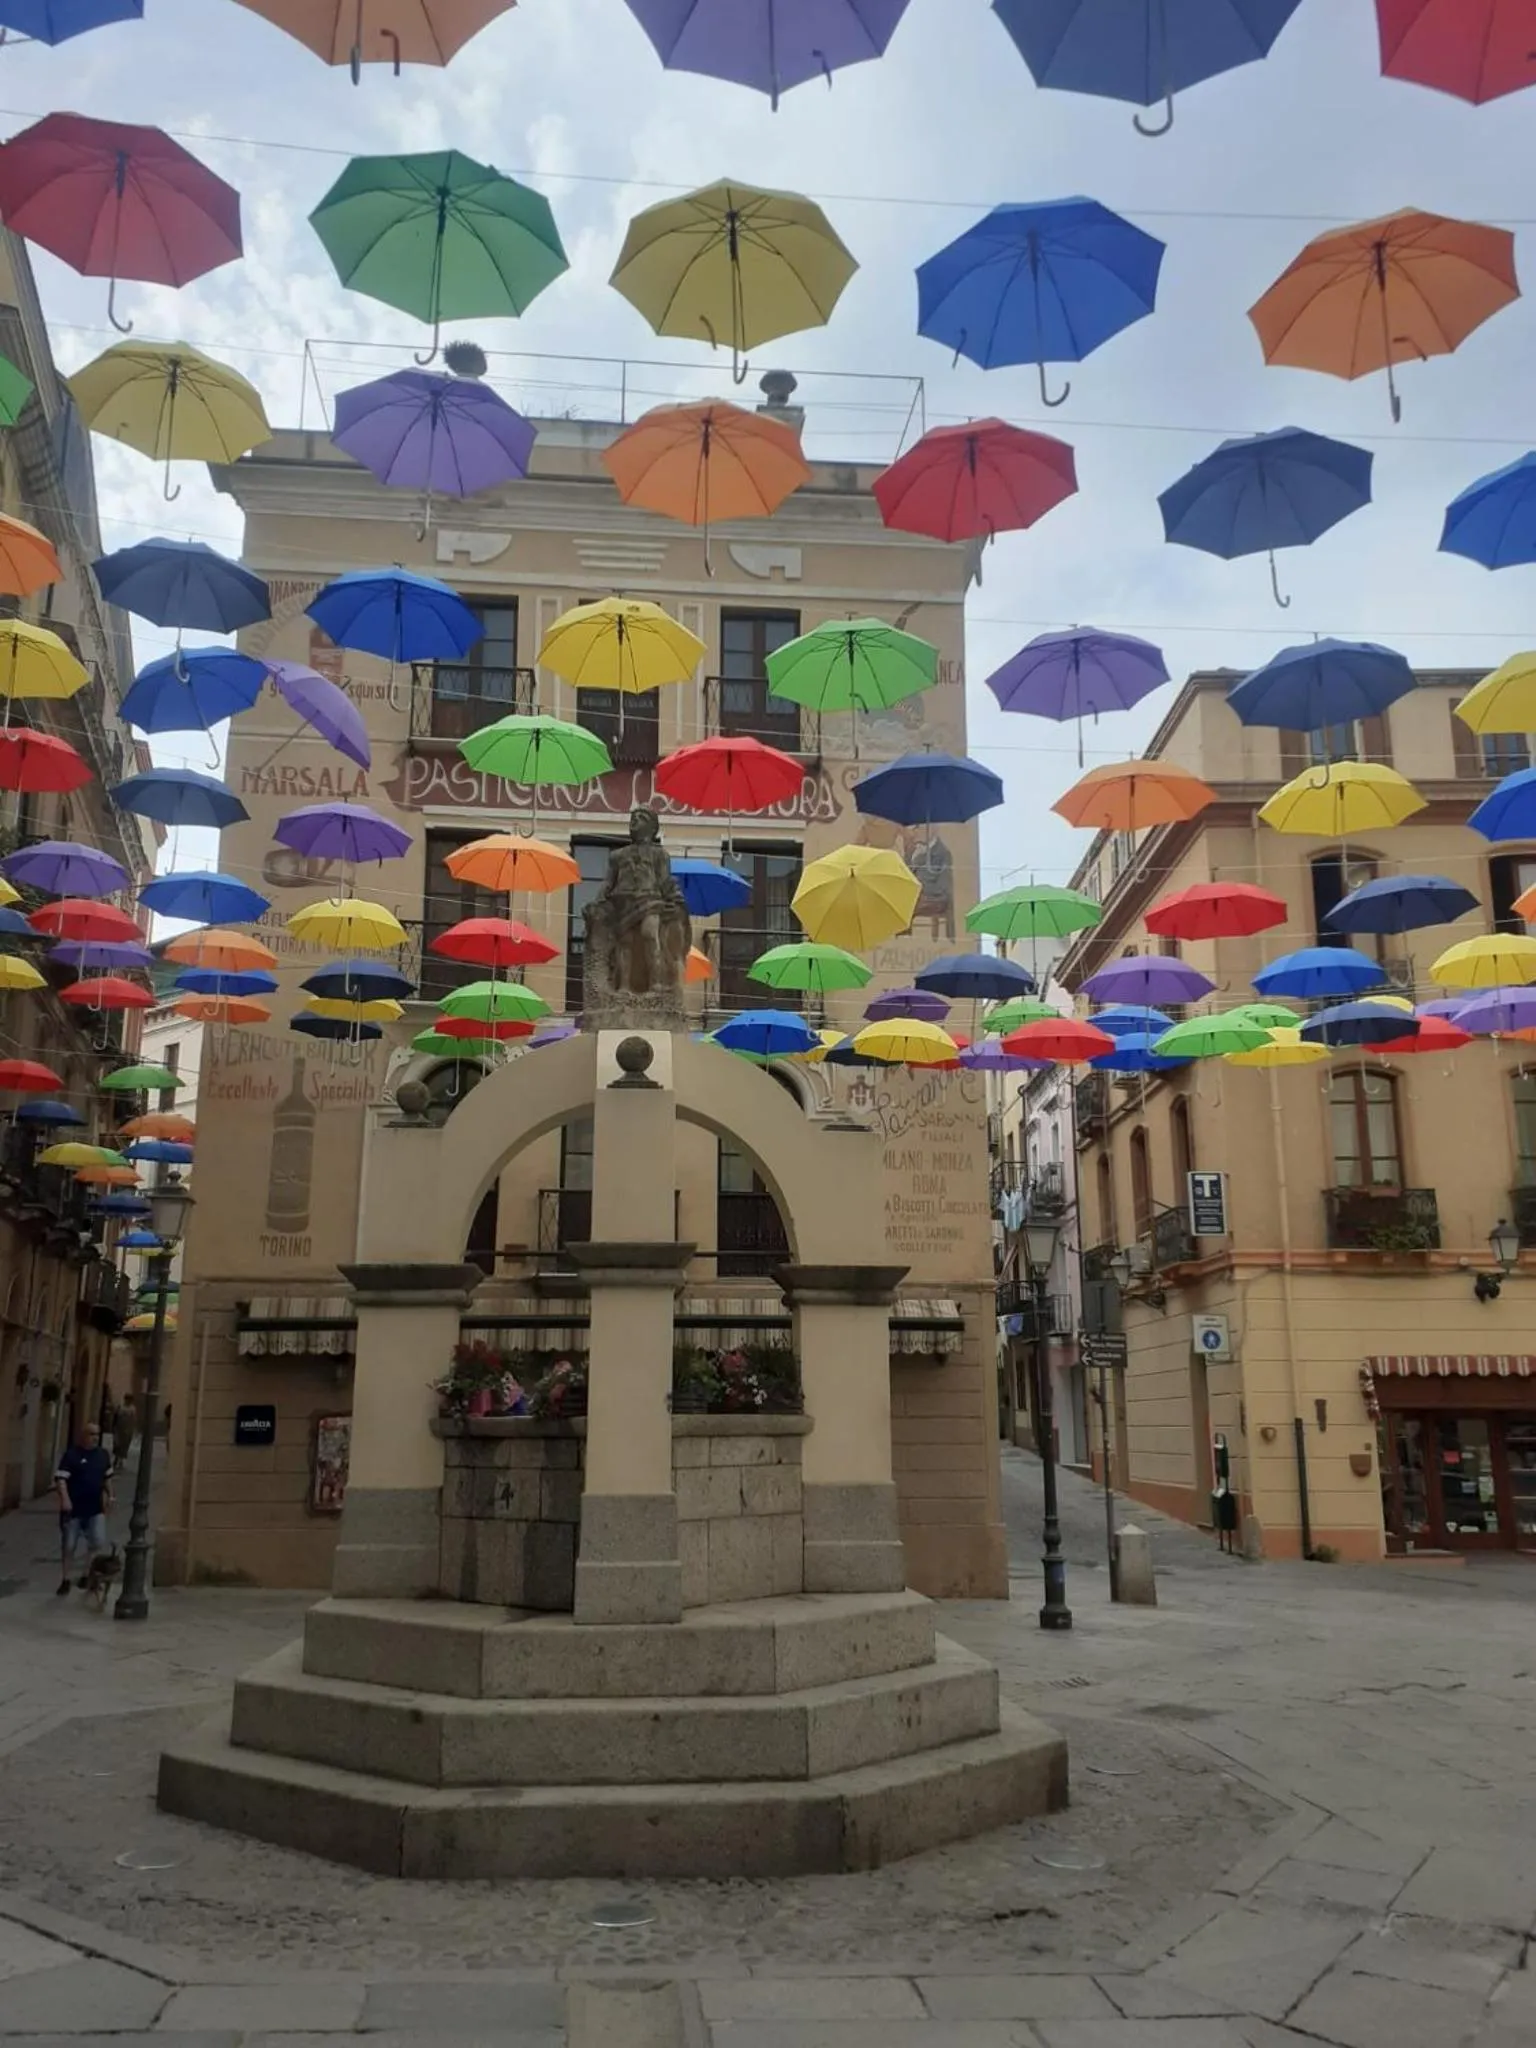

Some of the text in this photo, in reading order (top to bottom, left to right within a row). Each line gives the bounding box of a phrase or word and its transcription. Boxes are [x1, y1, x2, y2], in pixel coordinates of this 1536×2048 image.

[241, 764, 370, 797] MARSALA
[1195, 1176, 1217, 1197] T
[259, 1235, 313, 1258] TORINO
